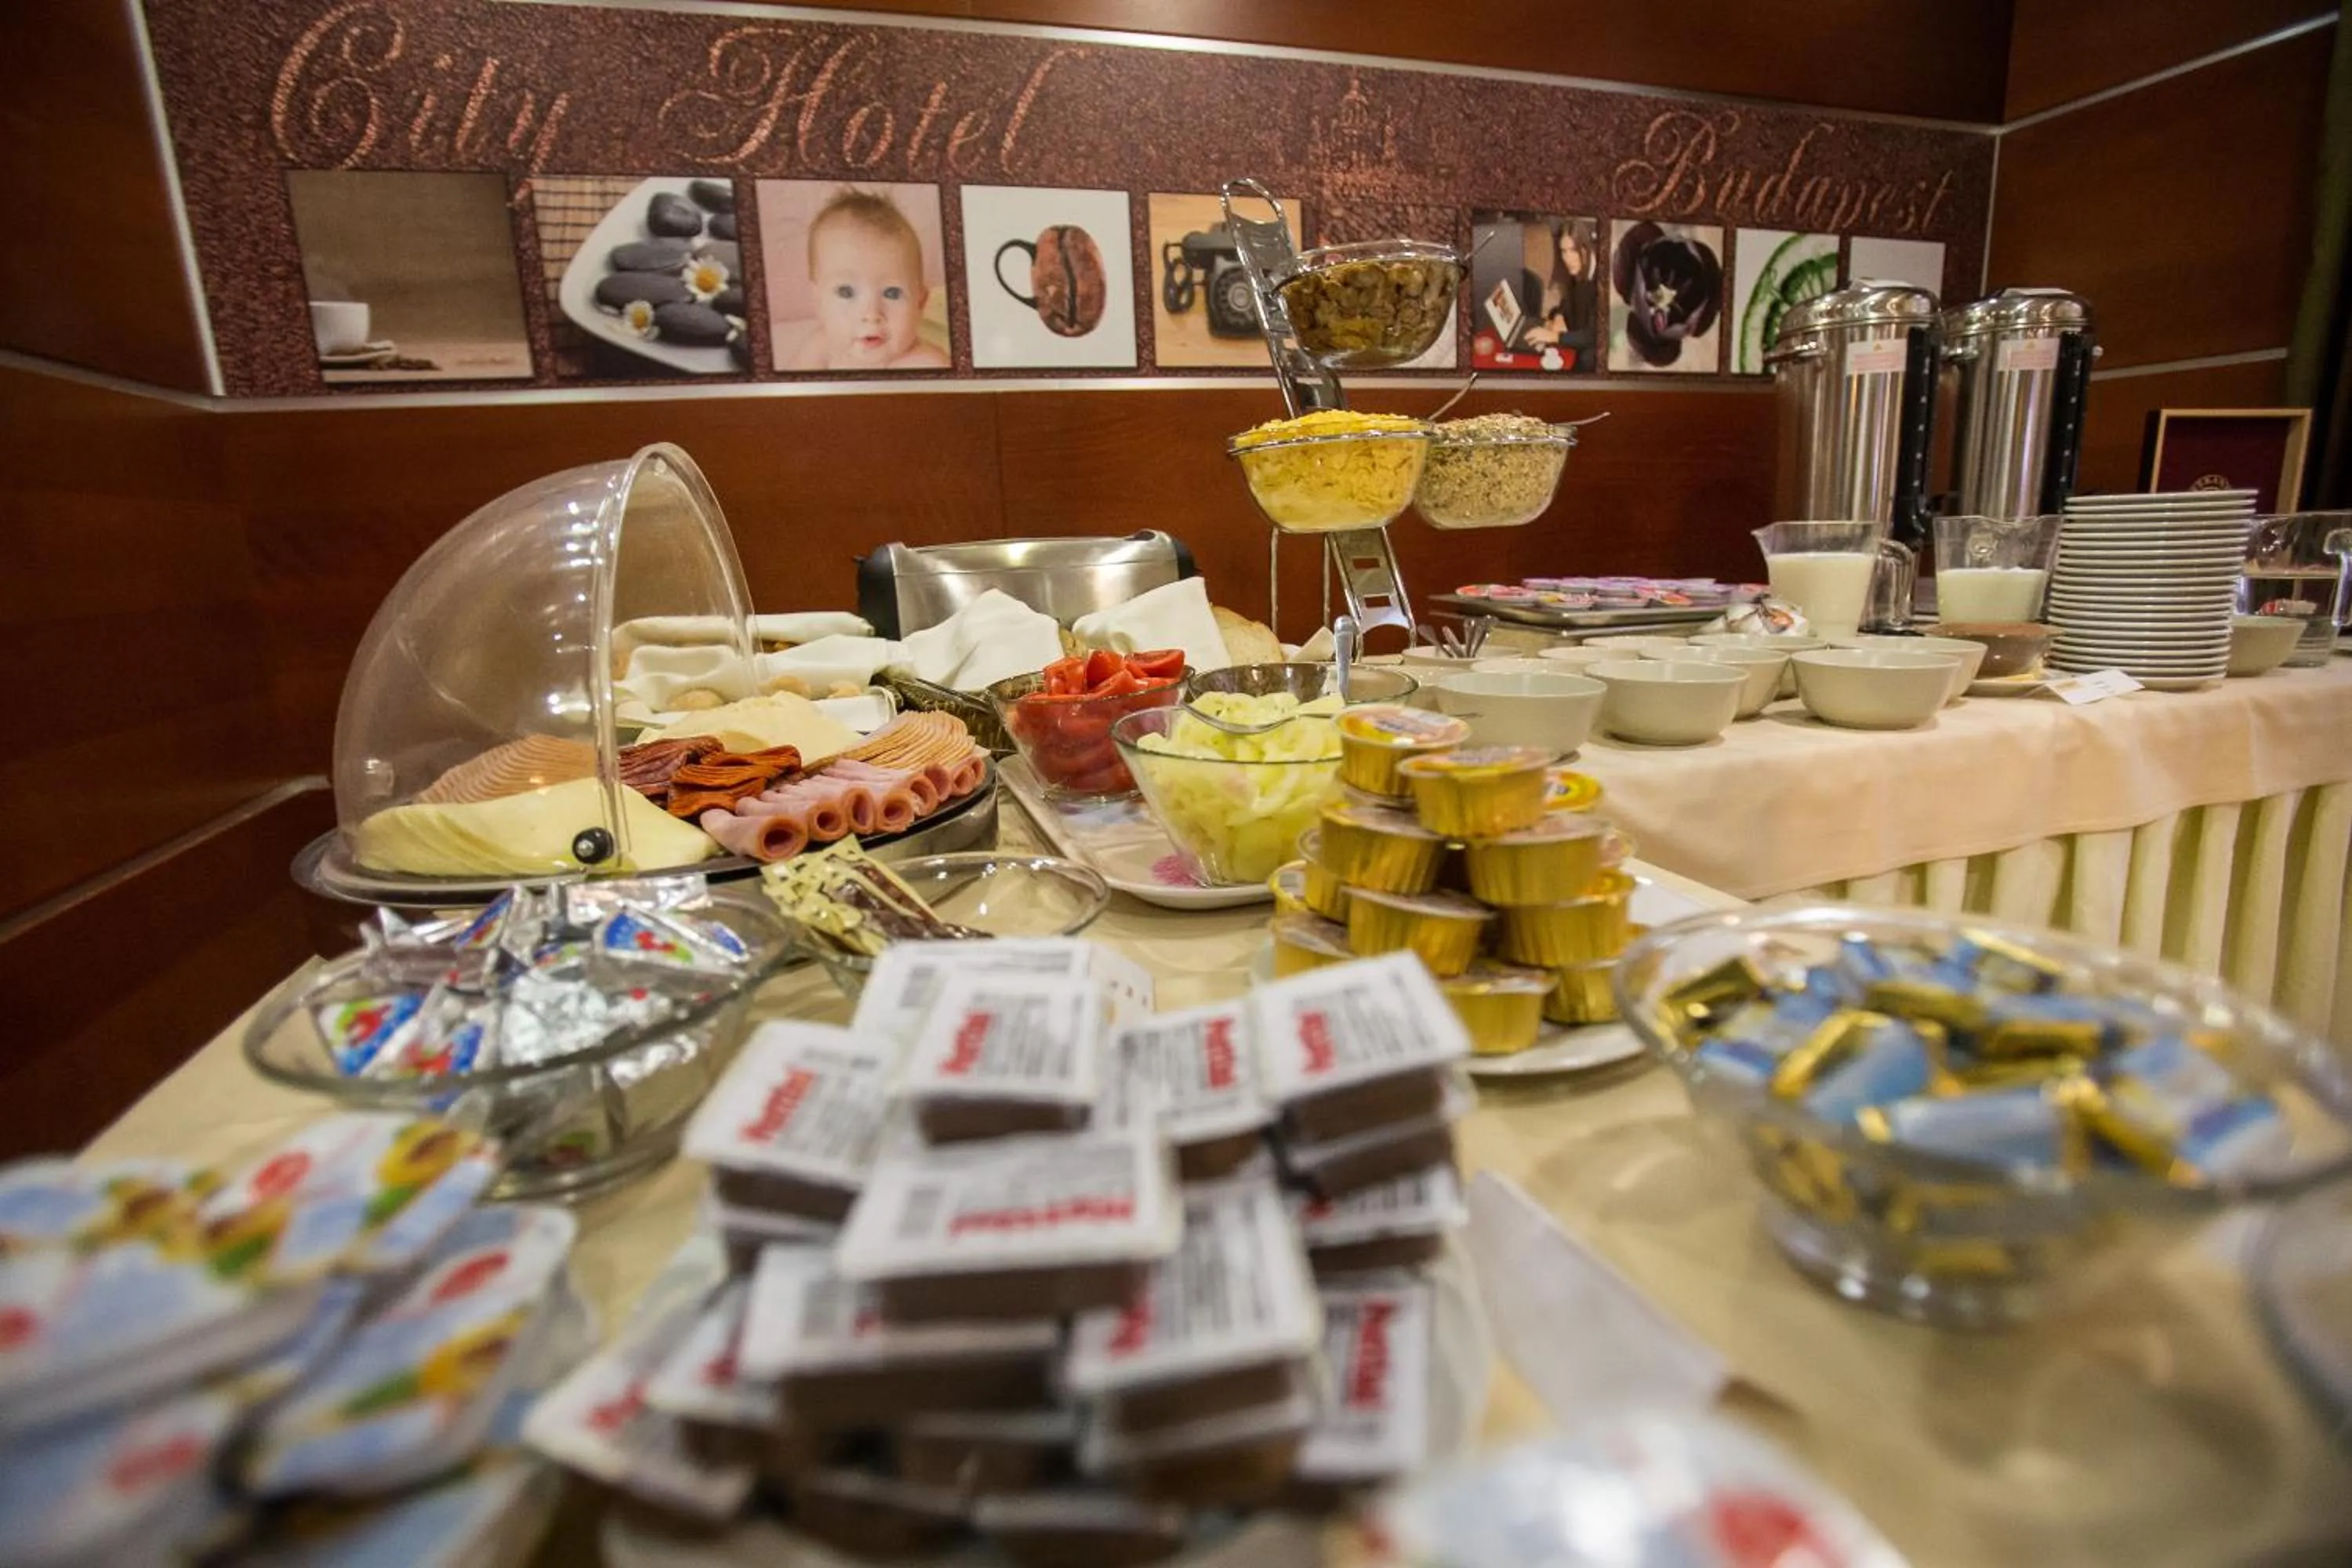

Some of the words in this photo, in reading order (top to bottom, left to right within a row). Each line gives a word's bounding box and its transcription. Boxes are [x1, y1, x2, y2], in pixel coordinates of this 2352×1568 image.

[270, 0, 570, 209] City
[659, 27, 1096, 174] Hotel
[1612, 110, 1954, 233] Budapest
